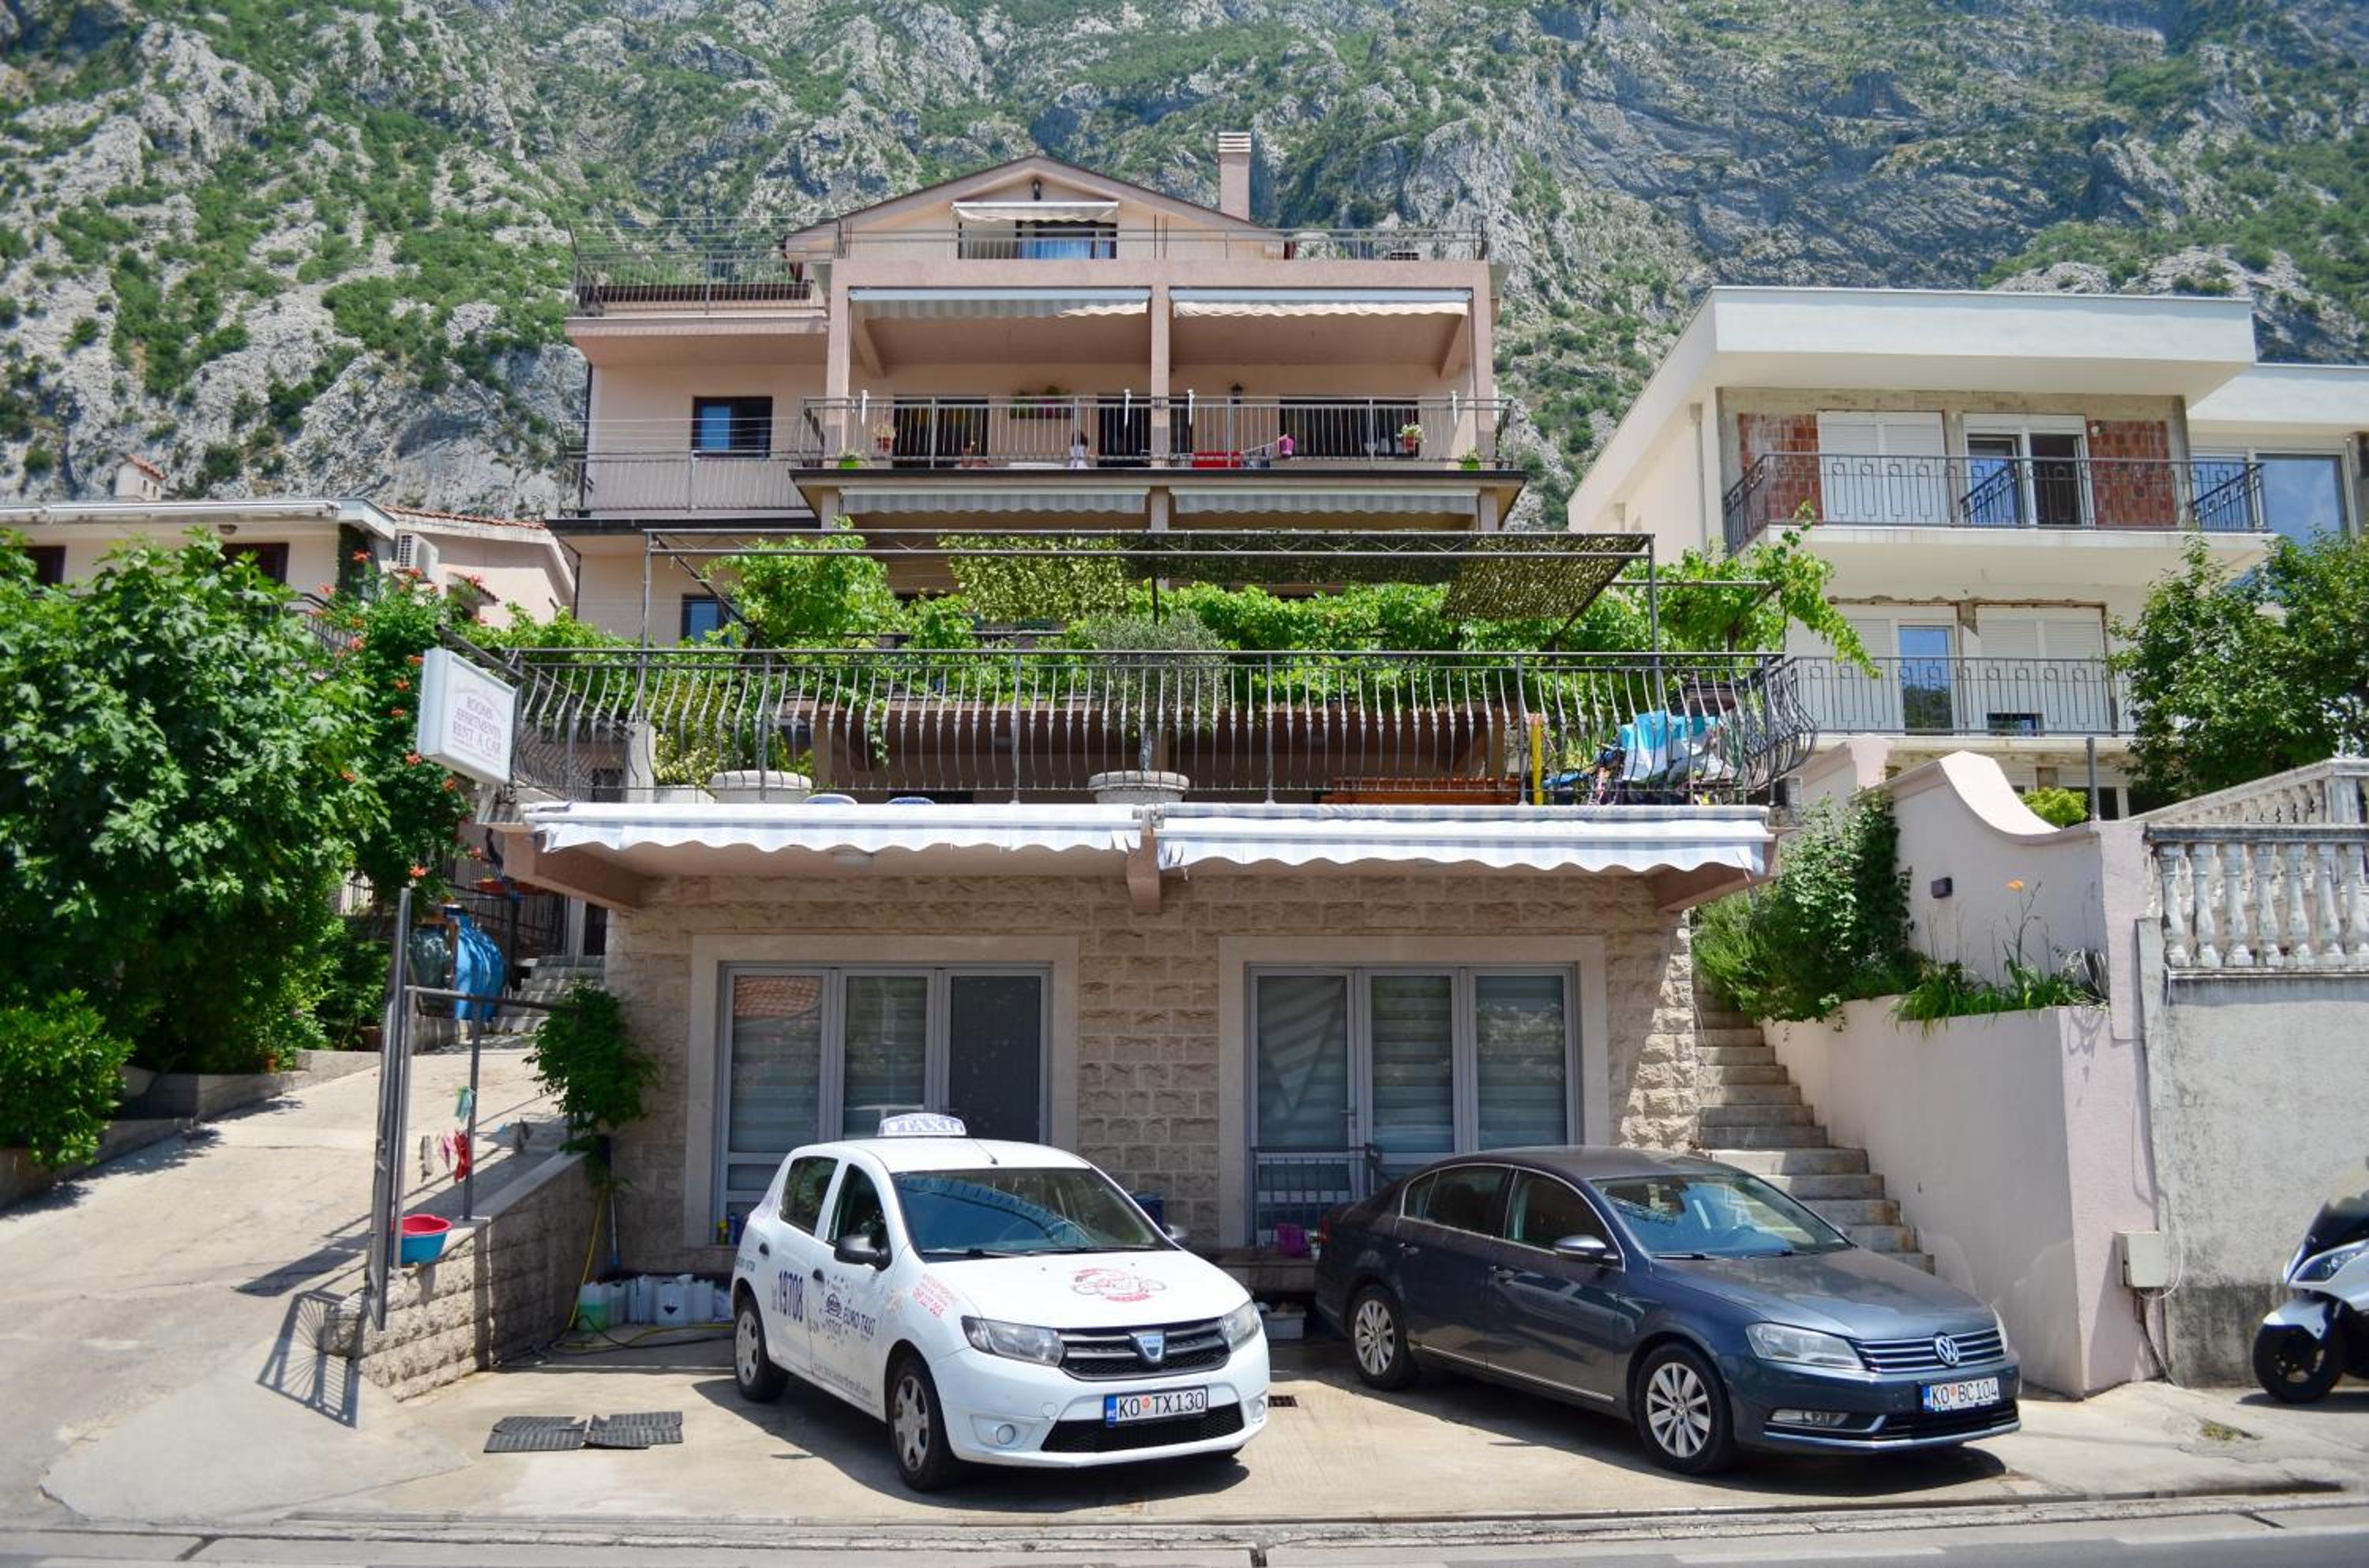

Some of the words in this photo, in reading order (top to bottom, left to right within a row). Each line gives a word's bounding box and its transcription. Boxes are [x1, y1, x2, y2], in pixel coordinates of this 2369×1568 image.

[453, 720, 473, 741] RENT
[486, 737, 501, 756] CAR
[899, 1118, 951, 1131] TAXI
[779, 1269, 803, 1322] 19708
[1119, 1397, 1140, 1418] KO
[1152, 1391, 1205, 1416] TX130
[1932, 1386, 1950, 1405] KO
[1958, 1380, 1998, 1403] BC104
